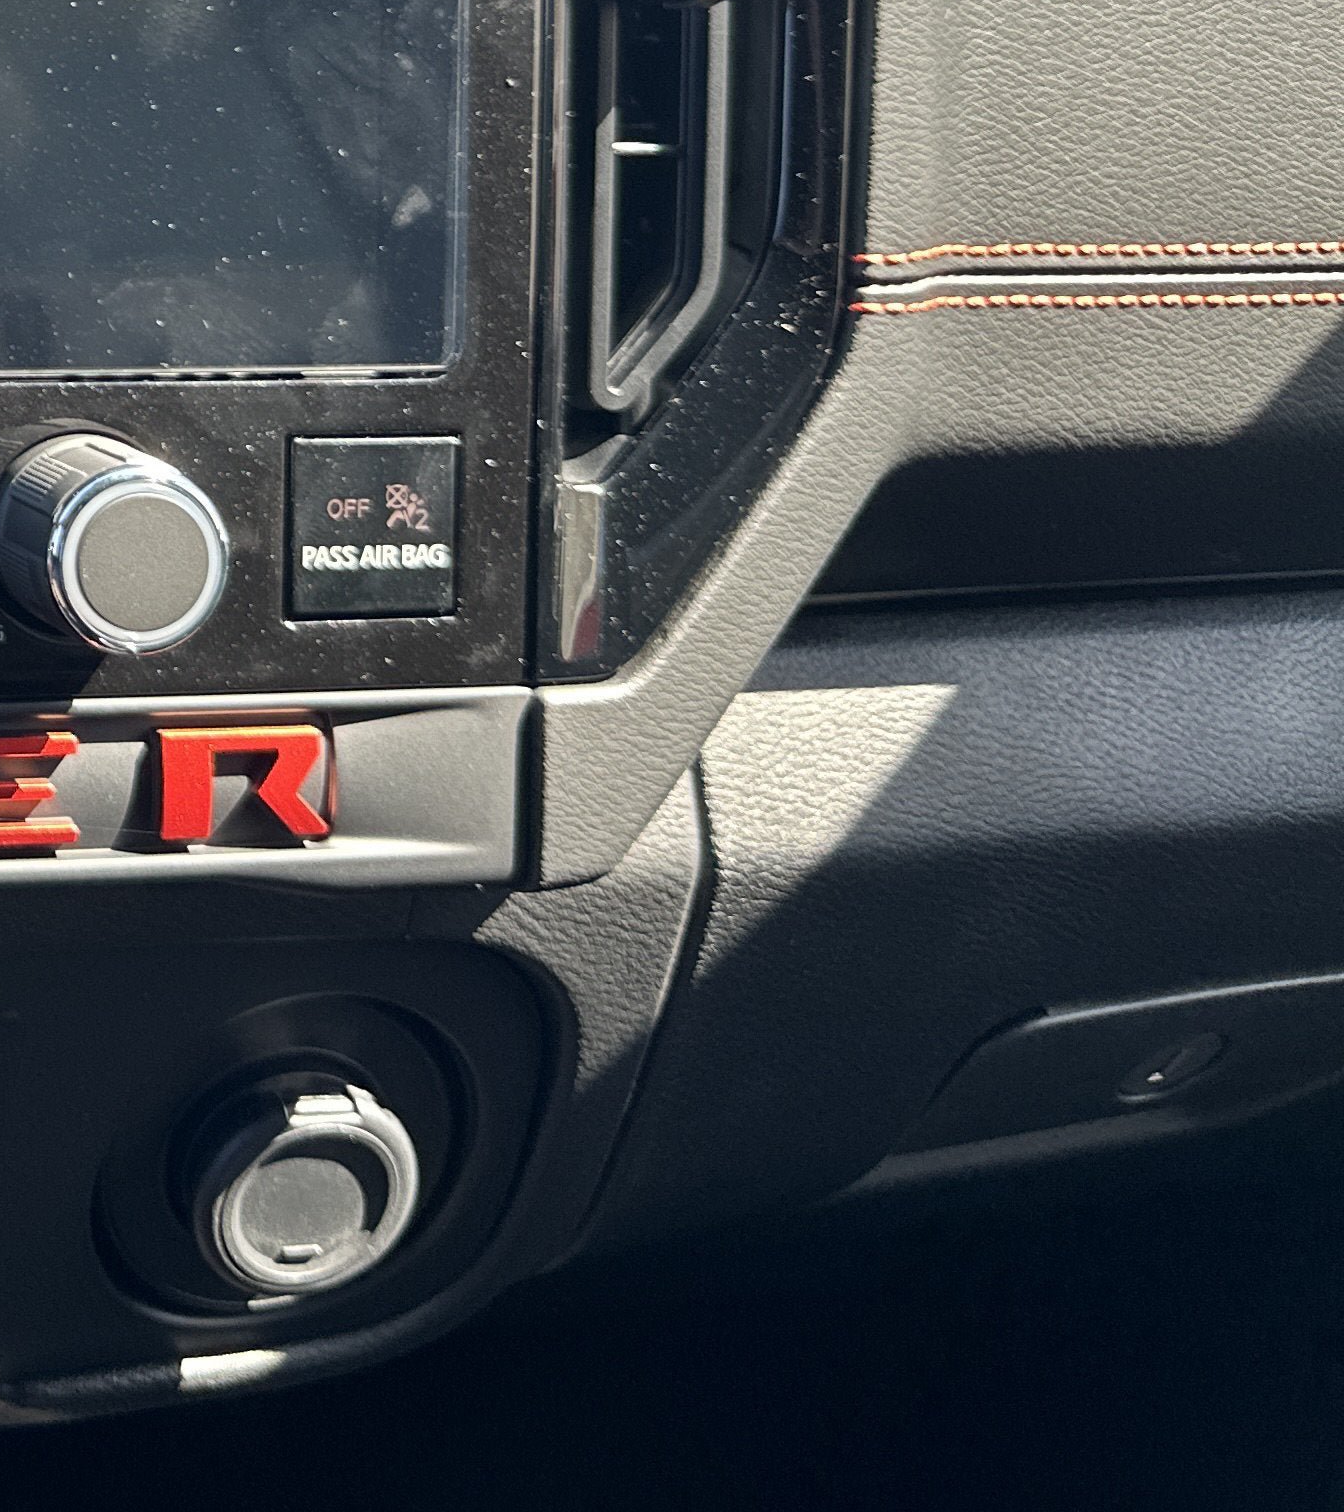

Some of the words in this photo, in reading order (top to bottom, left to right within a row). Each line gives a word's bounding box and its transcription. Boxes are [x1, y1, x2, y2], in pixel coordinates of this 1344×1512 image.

[326, 497, 370, 521] OFF
[301, 544, 359, 570] PASS
[360, 544, 399, 569] AIR
[401, 543, 451, 568] BAG
